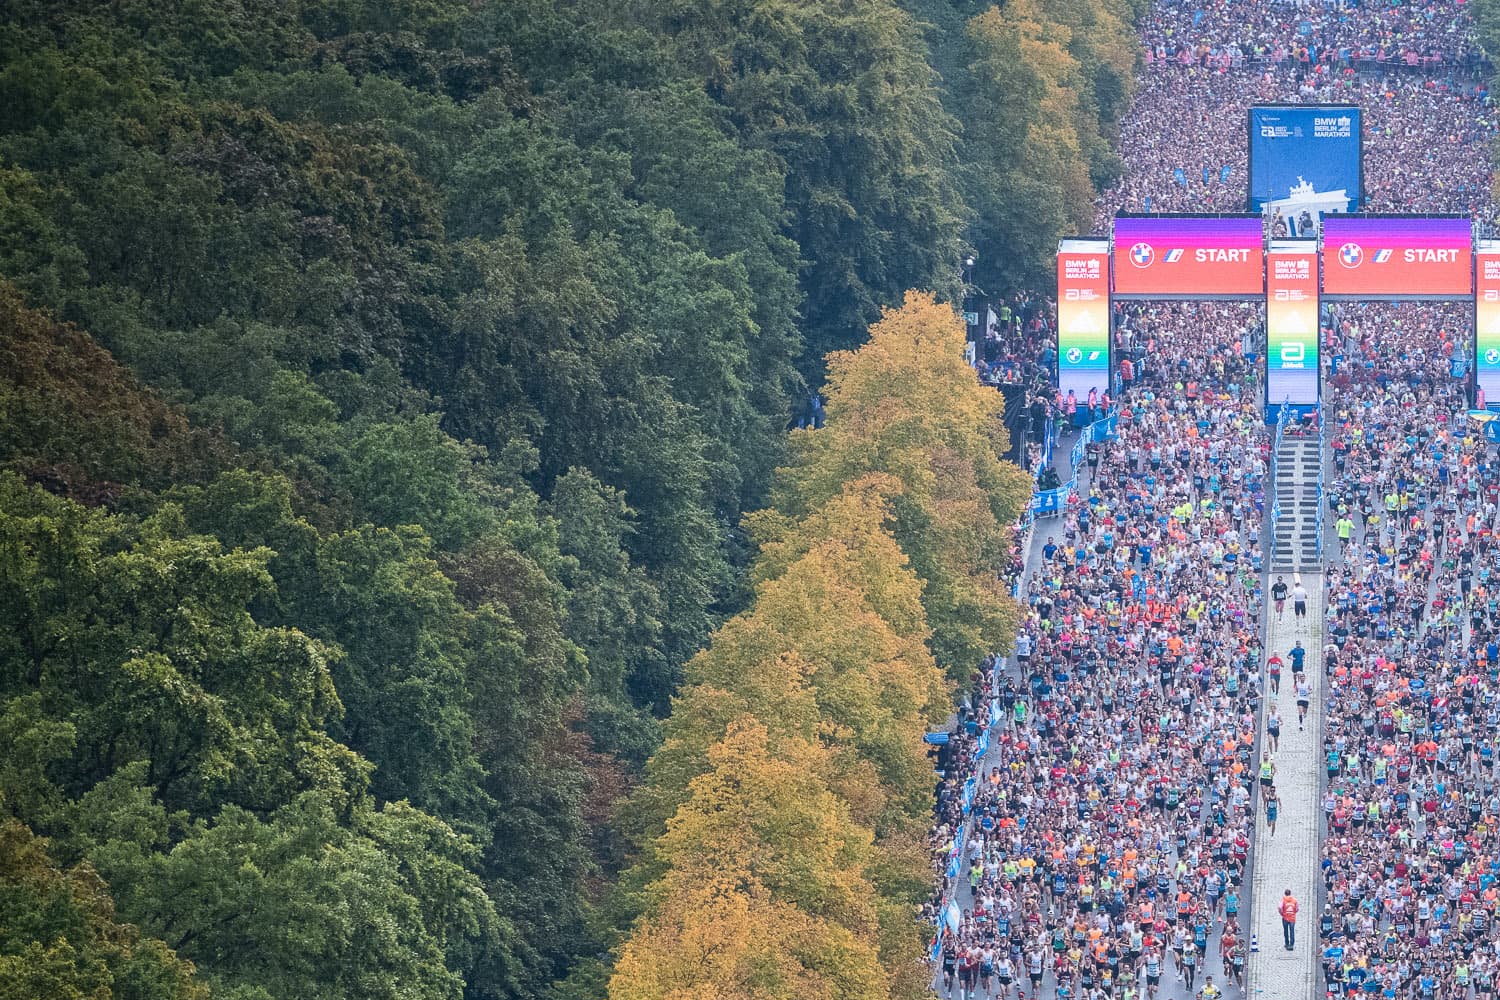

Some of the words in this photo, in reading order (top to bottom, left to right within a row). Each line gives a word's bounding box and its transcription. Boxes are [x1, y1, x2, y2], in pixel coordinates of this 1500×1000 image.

[1195, 248, 1251, 262] START
[1404, 248, 1459, 262] START
[1275, 260, 1296, 268] BMW
